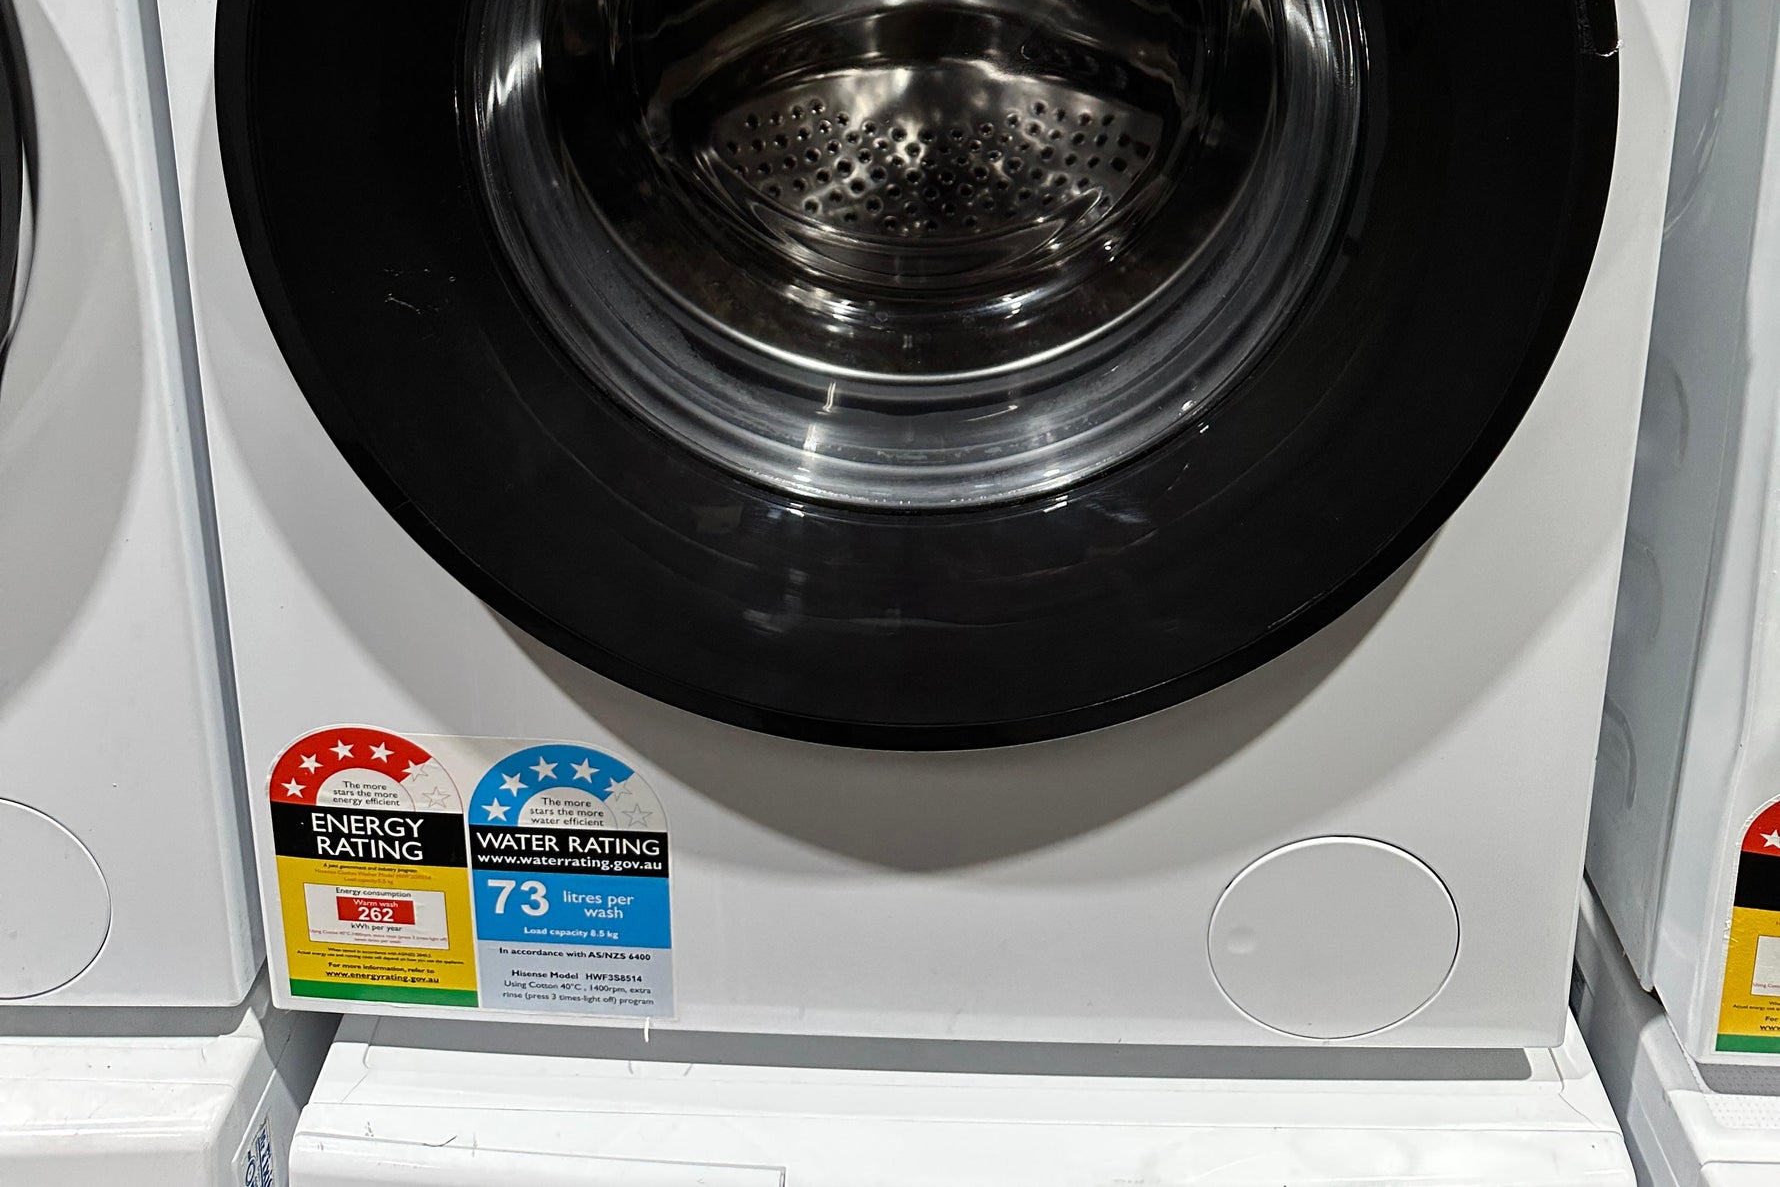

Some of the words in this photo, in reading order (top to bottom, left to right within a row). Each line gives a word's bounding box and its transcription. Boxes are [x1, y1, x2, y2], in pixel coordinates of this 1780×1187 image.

[342, 780, 361, 790] The
[363, 783, 387, 791] more
[333, 789, 355, 797] stars
[357, 789, 372, 797] the
[374, 791, 398, 799] more
[332, 797, 363, 806] energy
[365, 798, 400, 807] efficient
[541, 797, 562, 807] The
[564, 799, 592, 808] more
[529, 807, 555, 816] stars
[557, 807, 573, 816] the
[575, 809, 605, 818] more
[311, 812, 425, 838] ENERGY
[530, 817, 560, 825] water
[563, 817, 605, 827] efficient
[317, 836, 424, 861] RATING
[476, 832, 560, 852] WATER
[568, 836, 661, 856] RATING
[477, 853, 662, 871] www.waterrating.gov.au
[335, 887, 361, 896] Energy
[363, 889, 411, 898] consumption
[487, 879, 550, 917] 73
[562, 890, 603, 904] litres
[607, 894, 635, 907] per
[353, 899, 378, 907] Warm
[379, 900, 398, 908] wash
[357, 906, 394, 922] 262
[584, 906, 624, 919] wash
[351, 922, 370, 930] kWh
[386, 925, 402, 933] year
[524, 926, 548, 935] Load
[549, 927, 588, 938] capacity
[590, 929, 605, 938] 8.5
[606, 929, 619, 940] kg
[511, 948, 564, 958] accordance
[566, 950, 587, 958] with
[588, 951, 626, 961] AS/NZS
[628, 953, 651, 961] 6400
[362, 964, 407, 973] information,
[325, 971, 440, 984] www.energyrating.gov.au
[511, 969, 548, 979] Hisense
[550, 971, 579, 980] Model
[585, 973, 643, 983] HWF3S8514
[503, 980, 527, 989] Using
[528, 981, 559, 990] Cotton
[502, 991, 523, 999] rinse
[524, 992, 550, 1001] (press
[618, 998, 654, 1007] program
